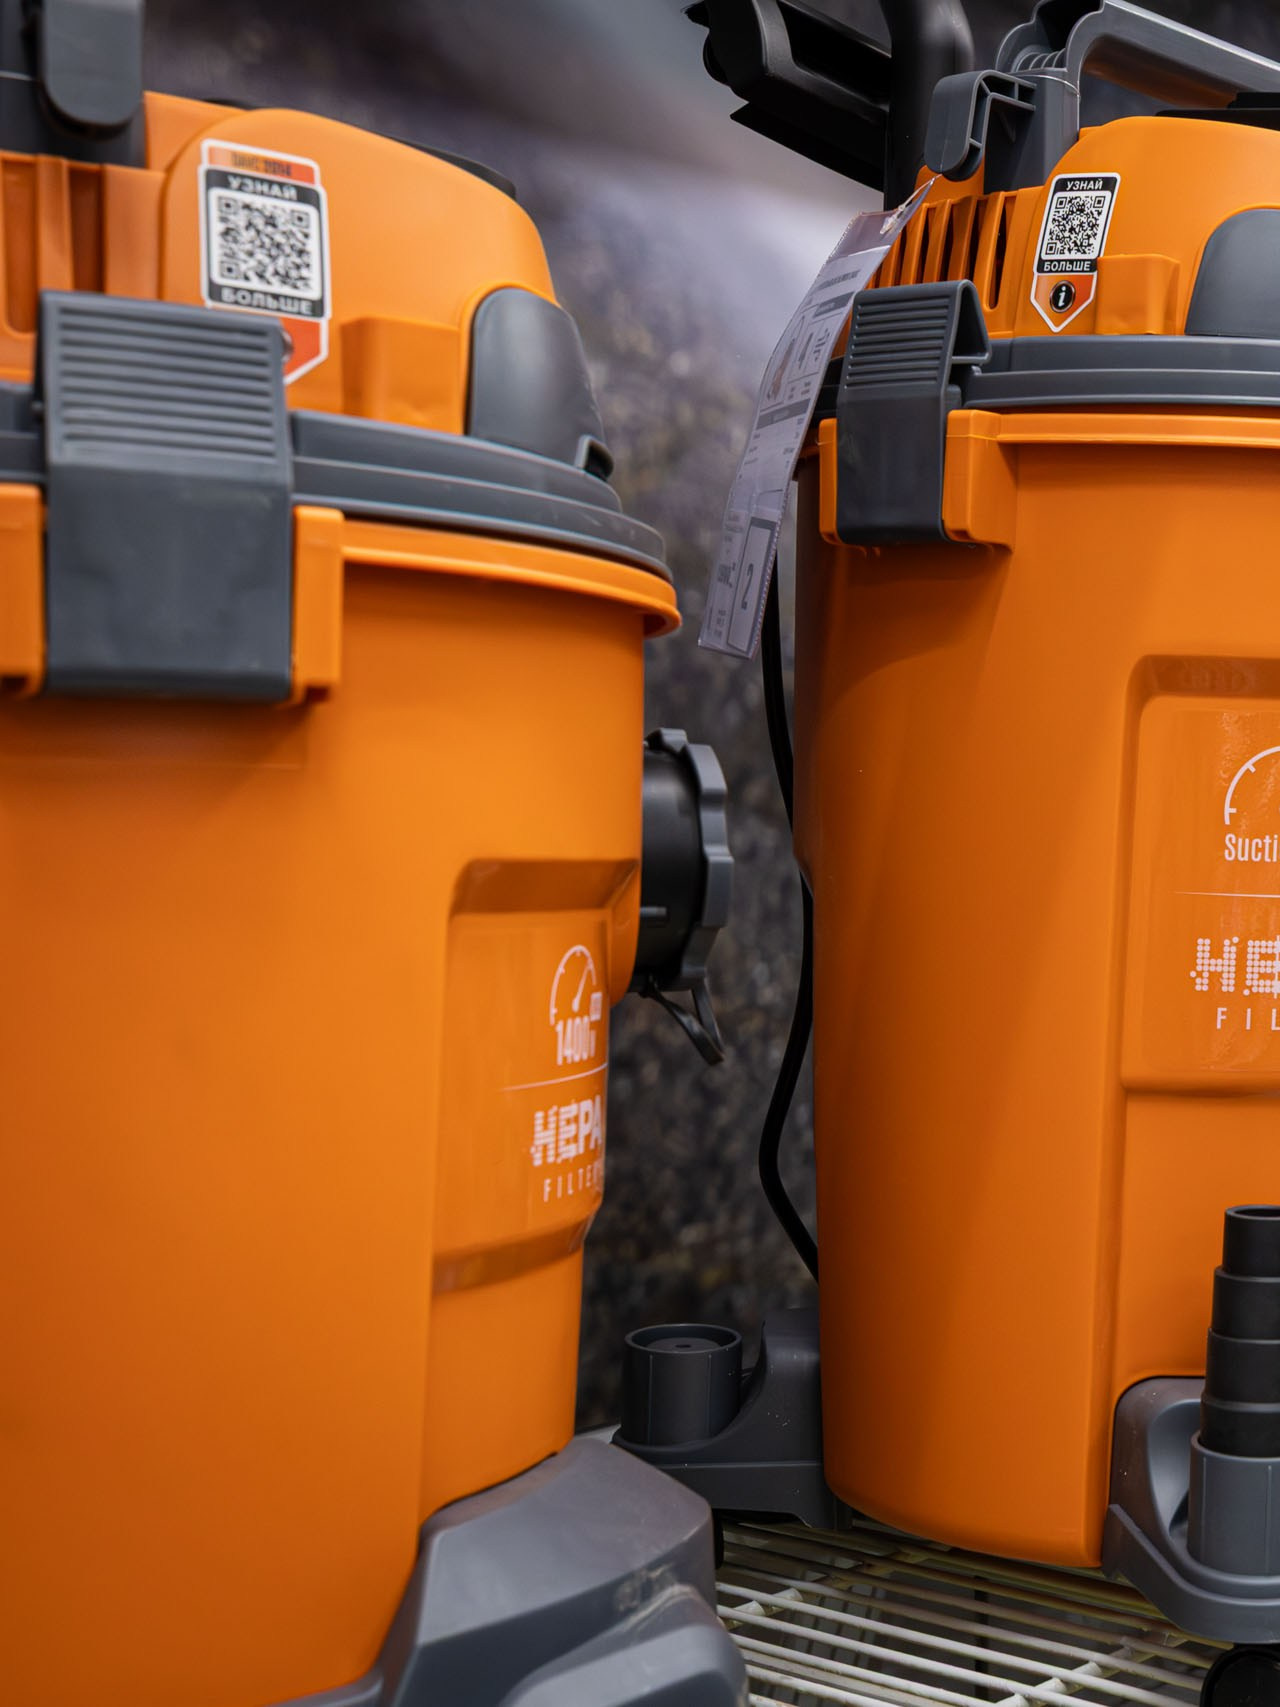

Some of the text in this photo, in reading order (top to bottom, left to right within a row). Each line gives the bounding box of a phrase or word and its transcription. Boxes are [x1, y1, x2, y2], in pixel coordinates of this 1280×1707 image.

[227, 175, 298, 201] УЗНАЙ
[1066, 178, 1103, 191] УЗНАЙ
[1043, 260, 1092, 272] БОЛЬШЕ
[220, 288, 313, 316] БОЛЬШЕ
[530, 1094, 603, 1167] HEPA
